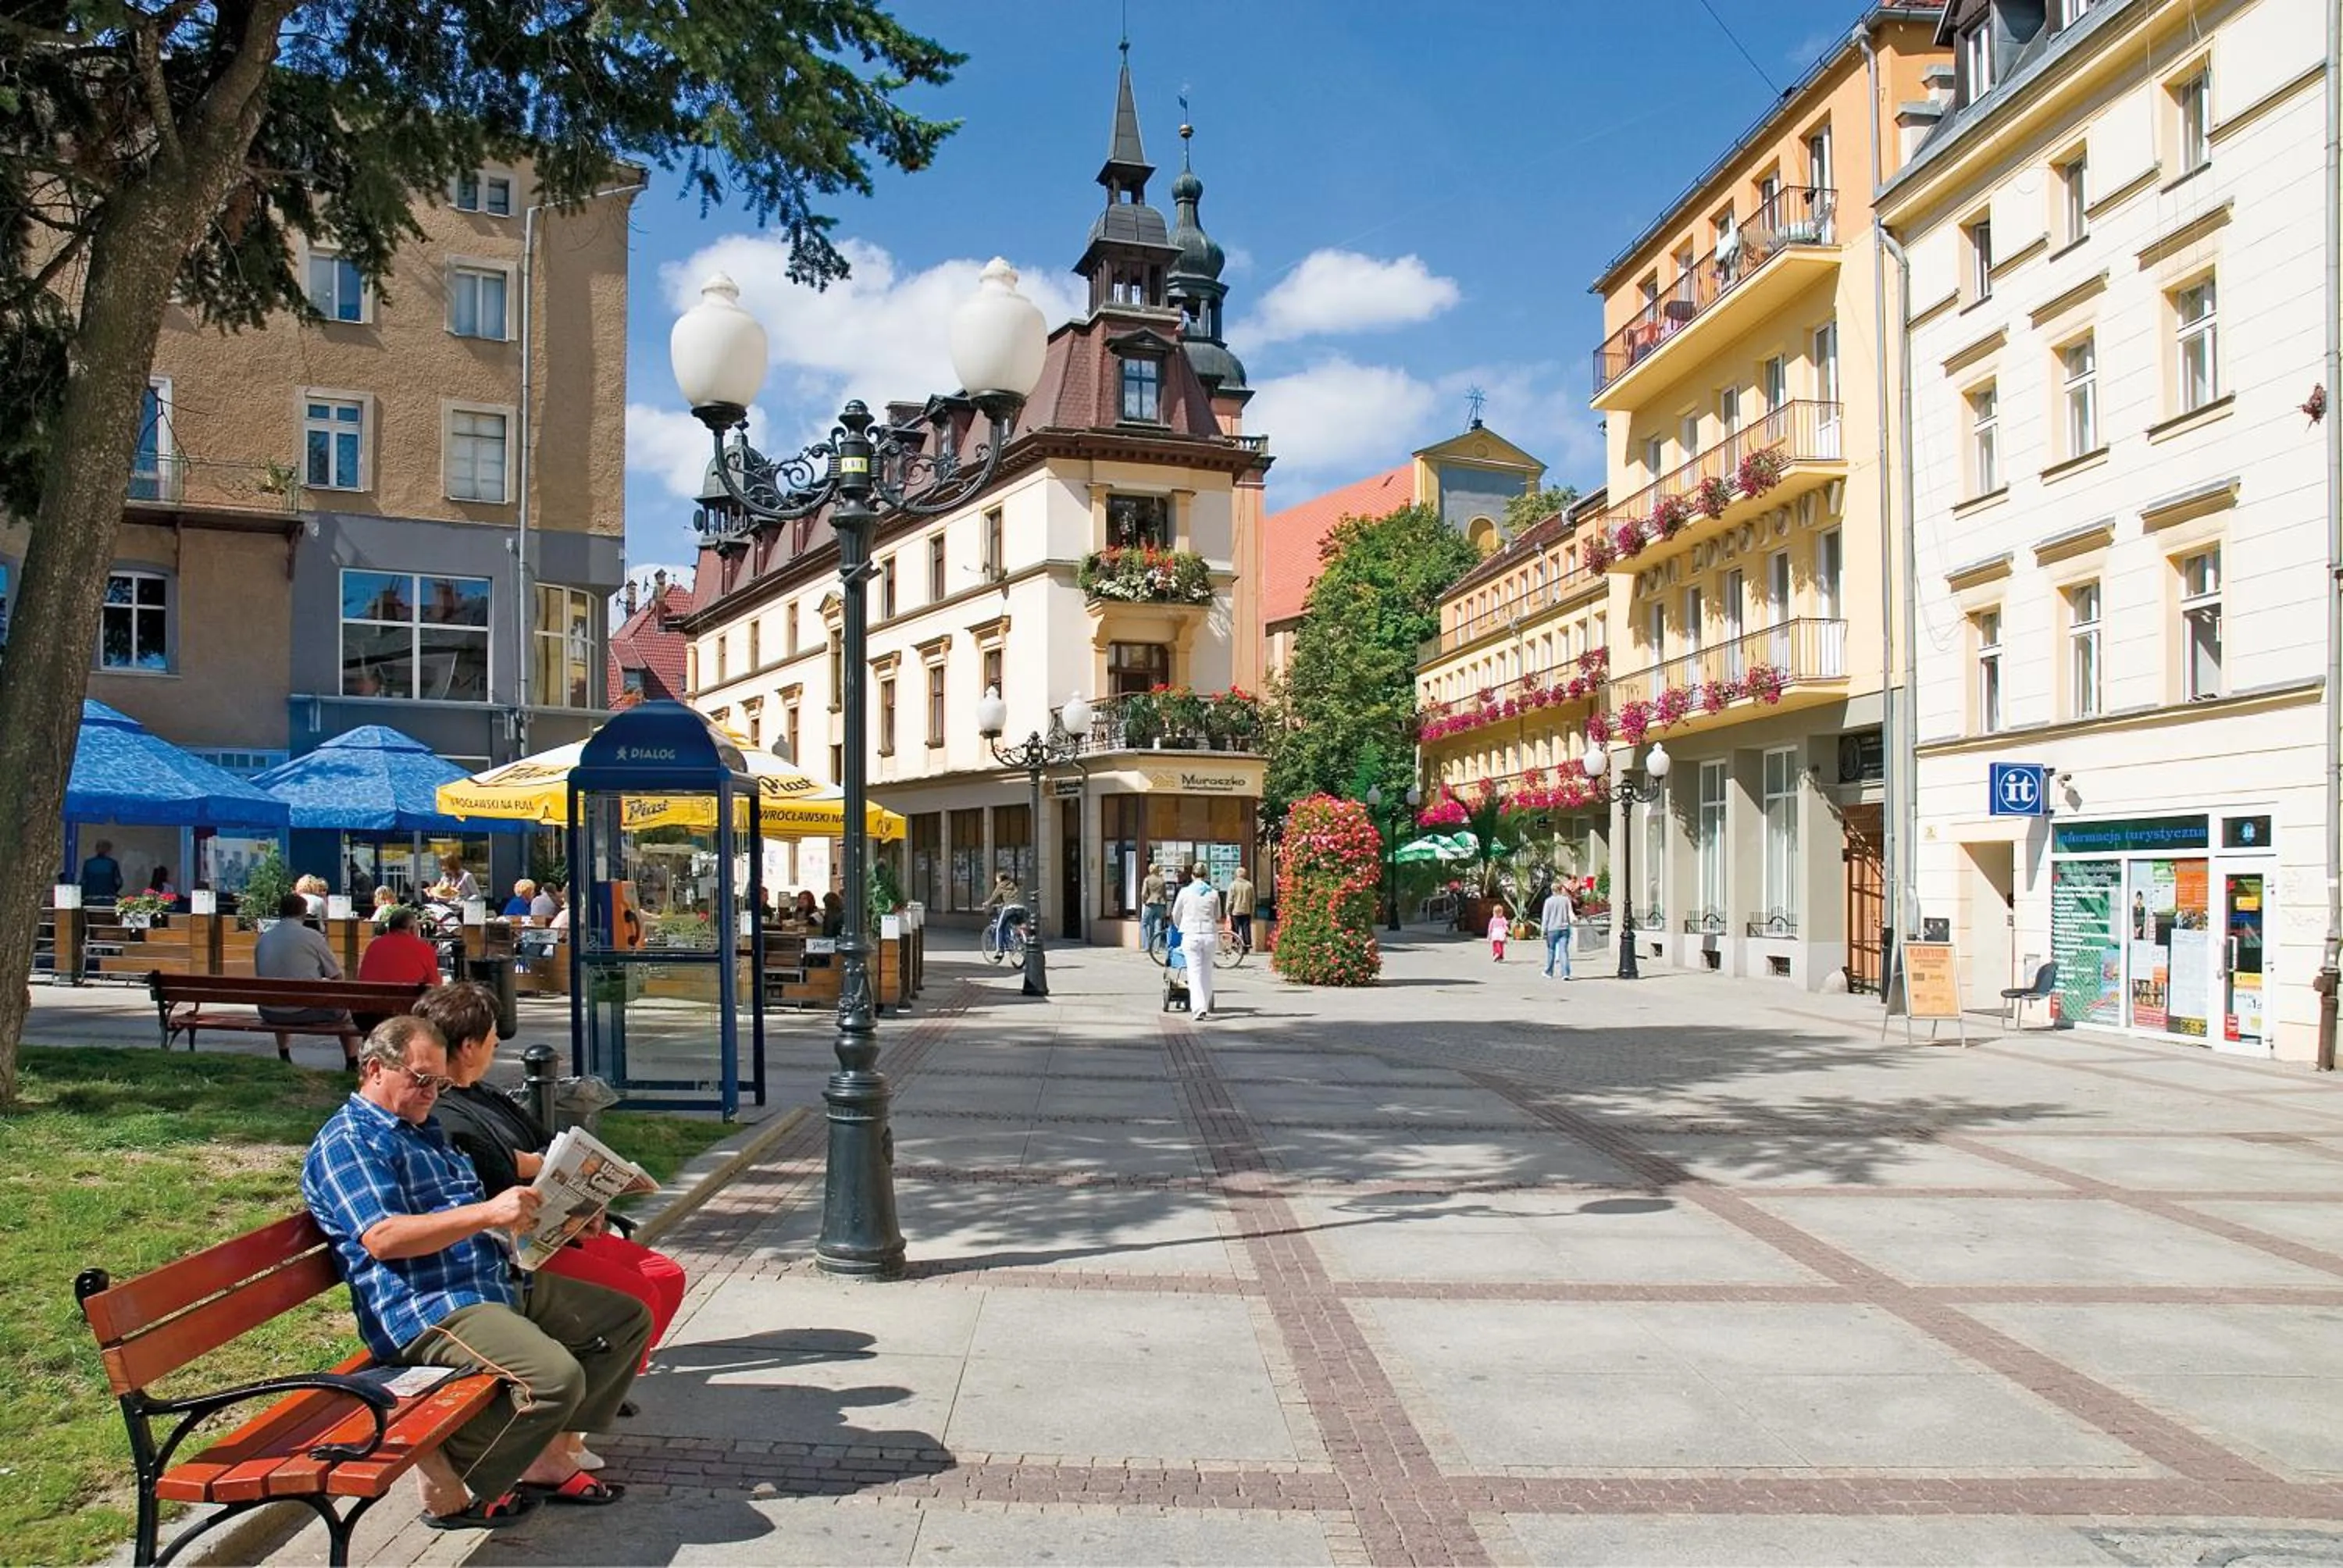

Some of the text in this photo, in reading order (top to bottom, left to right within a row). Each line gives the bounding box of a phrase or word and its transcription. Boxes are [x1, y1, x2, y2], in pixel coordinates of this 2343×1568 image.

[629, 747, 676, 760] DIALOG
[758, 775, 815, 795] Piast
[2005, 774, 2035, 802] it
[501, 800, 513, 810] NA
[626, 798, 669, 821] Piast
[759, 809, 830, 823] WROCŁAWSKI
[2125, 826, 2206, 843] turystyczna
